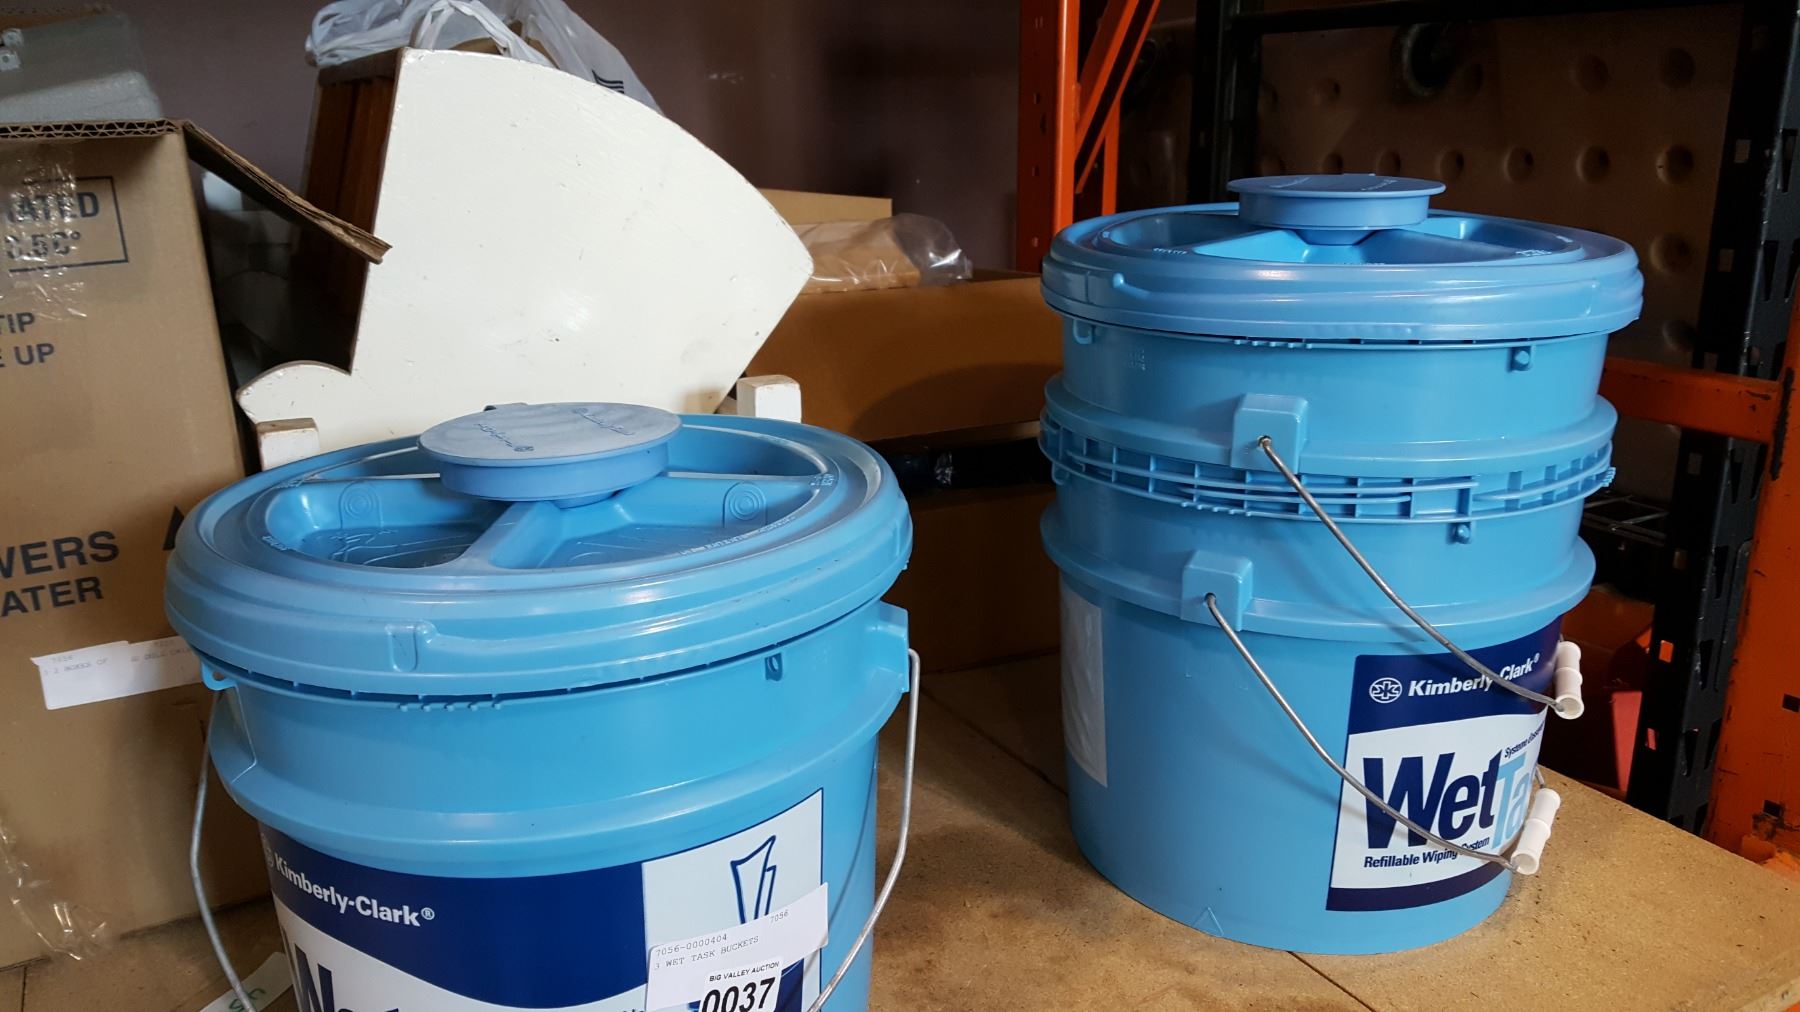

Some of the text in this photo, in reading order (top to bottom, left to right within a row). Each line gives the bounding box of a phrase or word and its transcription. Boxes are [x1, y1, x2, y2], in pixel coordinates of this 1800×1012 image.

[14, 343, 54, 366] UP
[1363, 855, 1420, 868] Refillable
[1422, 848, 1458, 864] Wiping
[665, 956, 686, 968] WET
[691, 949, 716, 963] TASK
[720, 935, 760, 955] BUCKETS
[709, 960, 780, 982] BIG VALLEY AUCTION
[702, 976, 776, 1012] 0037
